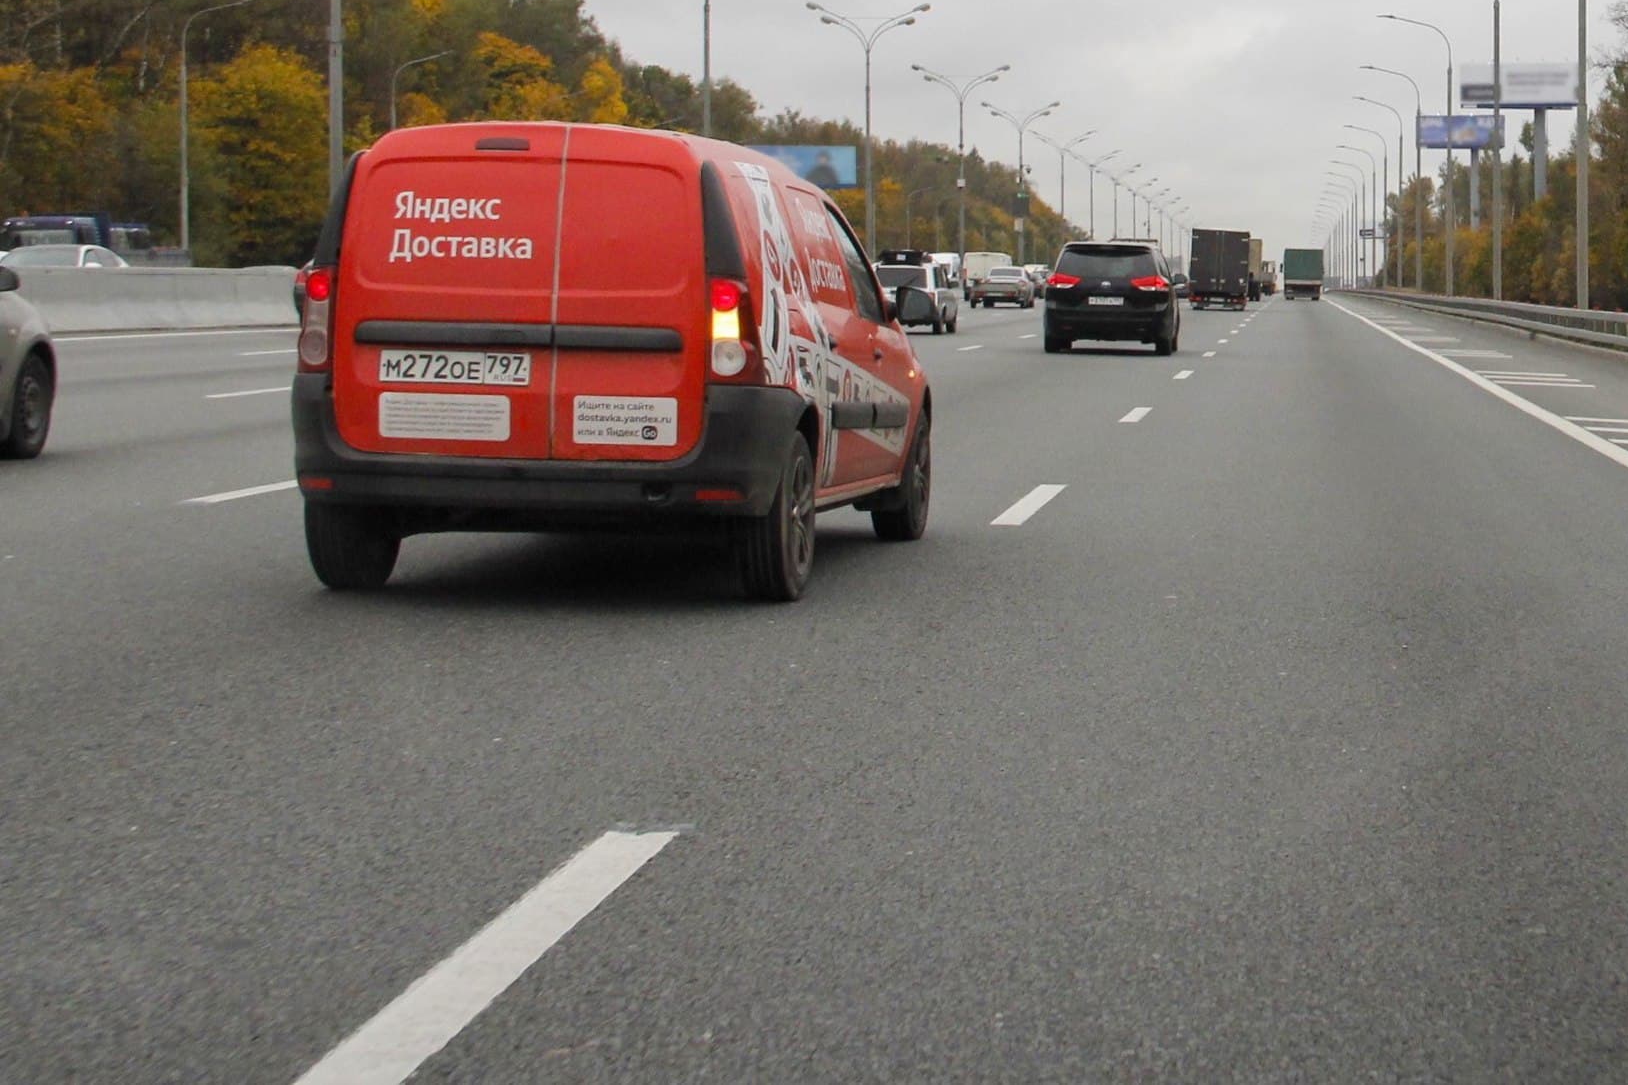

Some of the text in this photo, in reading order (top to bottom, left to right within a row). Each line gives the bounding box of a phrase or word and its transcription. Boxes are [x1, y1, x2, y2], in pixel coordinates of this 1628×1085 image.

[394, 191, 501, 223] Яндекс
[389, 229, 533, 263] Доставка
[627, 402, 655, 412] сайте
[578, 413, 672, 424] dostavka.yandex.ru
[606, 426, 640, 438] Яндекс
[643, 428, 656, 437] Go
